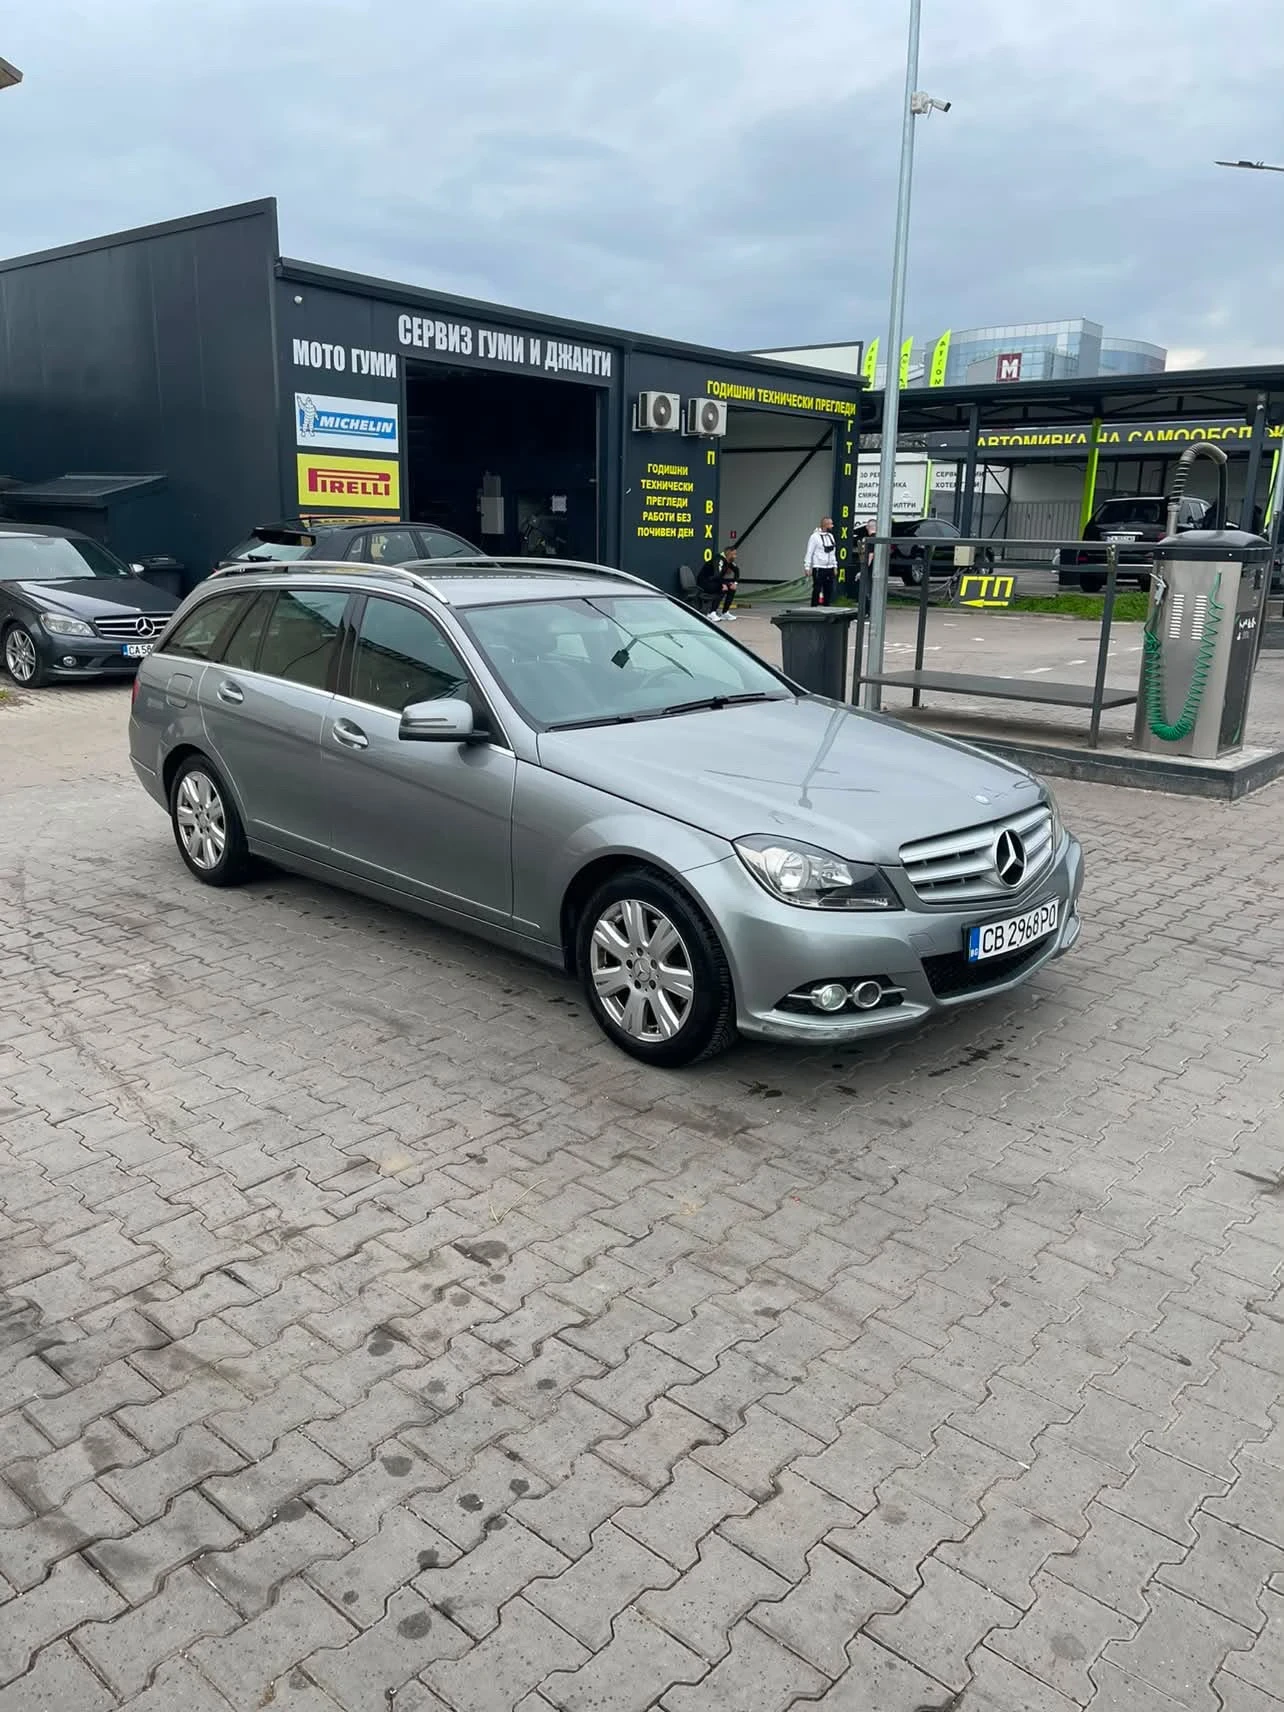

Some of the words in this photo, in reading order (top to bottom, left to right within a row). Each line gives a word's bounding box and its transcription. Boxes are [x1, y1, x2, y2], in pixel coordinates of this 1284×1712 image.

[398, 314, 472, 355] СЕРВИЗ
[478, 329, 524, 363] ГУМИ
[529, 338, 541, 366] И
[544, 341, 612, 377] ДЖАНТИ
[292, 338, 346, 372] МОТО
[351, 348, 398, 379] ГУМИ
[706, 380, 755, 401] ГОДИШНИ
[757, 388, 814, 410] ТЕХНИЧЕСКИ
[815, 397, 857, 417] ПРЕГЛЕДИ
[319, 414, 395, 434] MICHELIN
[647, 463, 689, 476] ГОДИШНИ
[308, 467, 391, 496] PIRELLI
[640, 479, 694, 493] ТЕХНИЧЕСКИ
[646, 496, 689, 509] ПРЕГЛЕДИ
[642, 511, 675, 523] РАБОТИ
[676, 512, 692, 524] БЕЗ
[637, 526, 676, 538] ПОЧИВЕН
[677, 527, 695, 539] ДЕН
[959, 576, 1014, 598] ГТП
